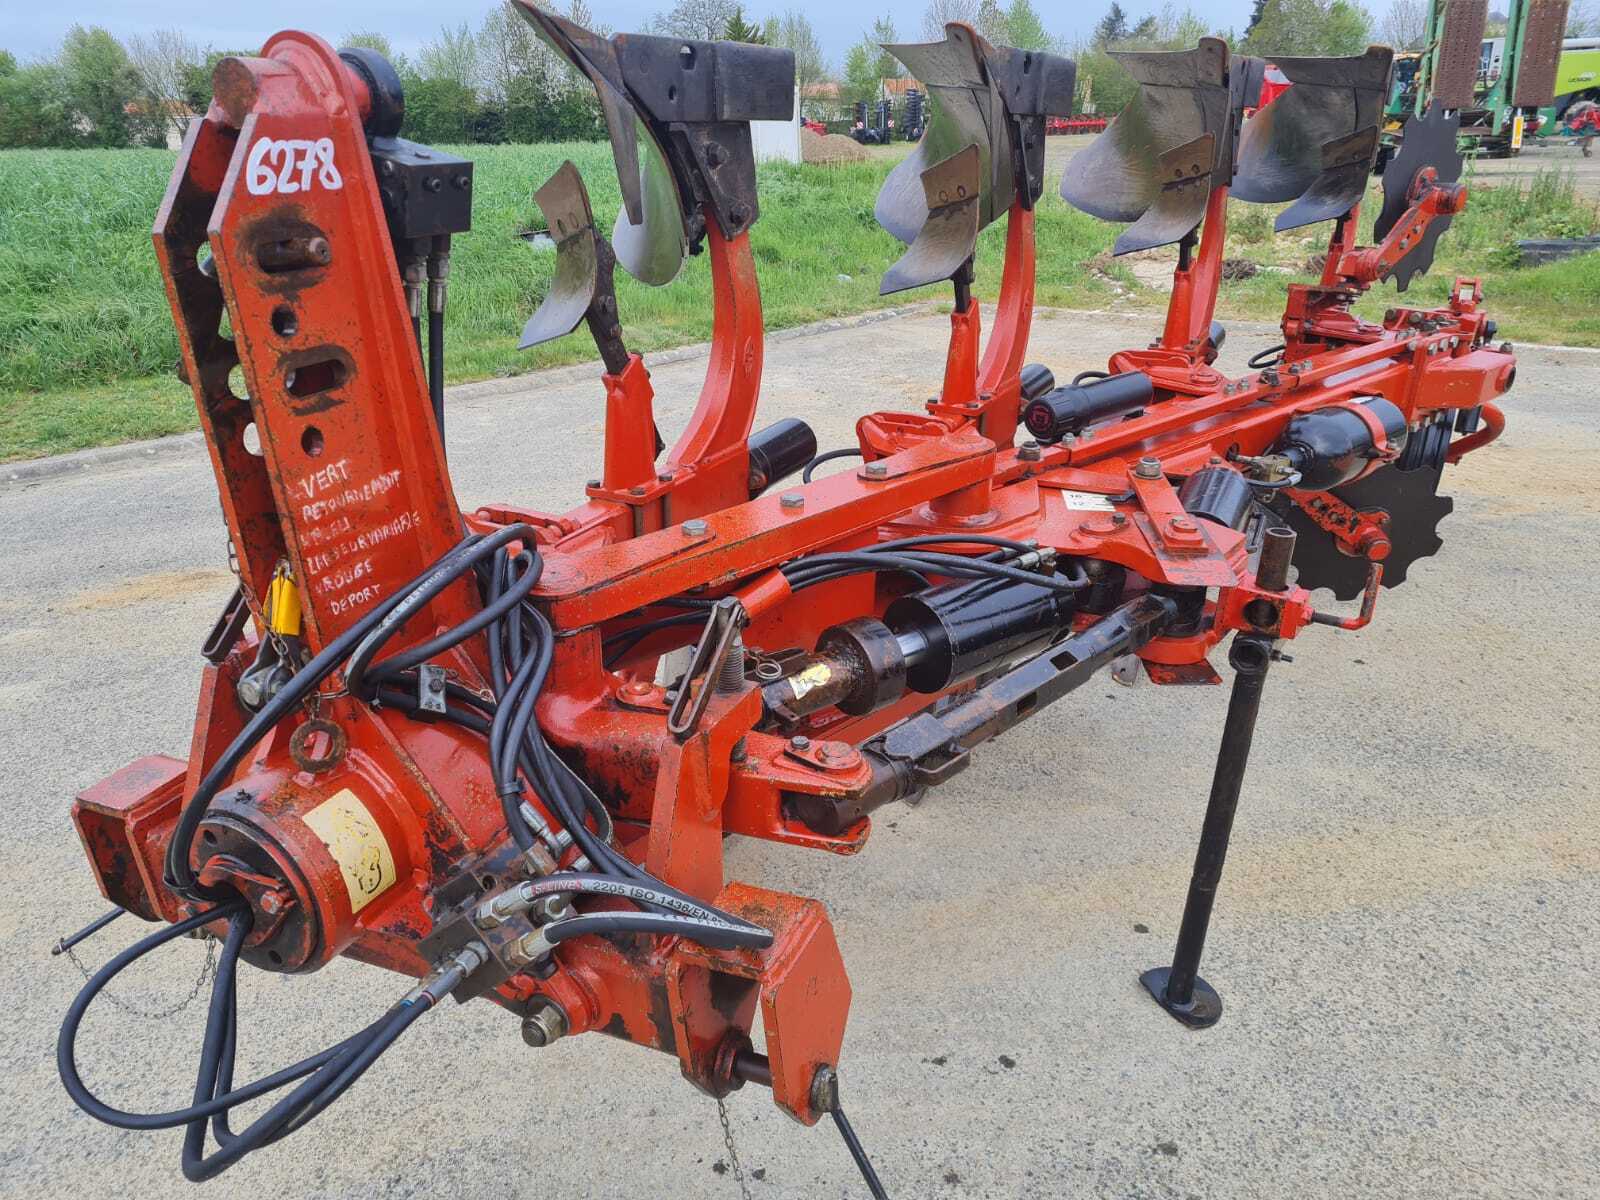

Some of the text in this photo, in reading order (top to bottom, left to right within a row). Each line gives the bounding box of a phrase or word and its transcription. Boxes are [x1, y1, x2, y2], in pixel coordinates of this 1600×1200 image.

[246, 136, 343, 195] 6278
[300, 459, 350, 498] VERT
[330, 583, 381, 616] DEPORT
[592, 881, 625, 895] 2205
[629, 888, 655, 902] ISO
